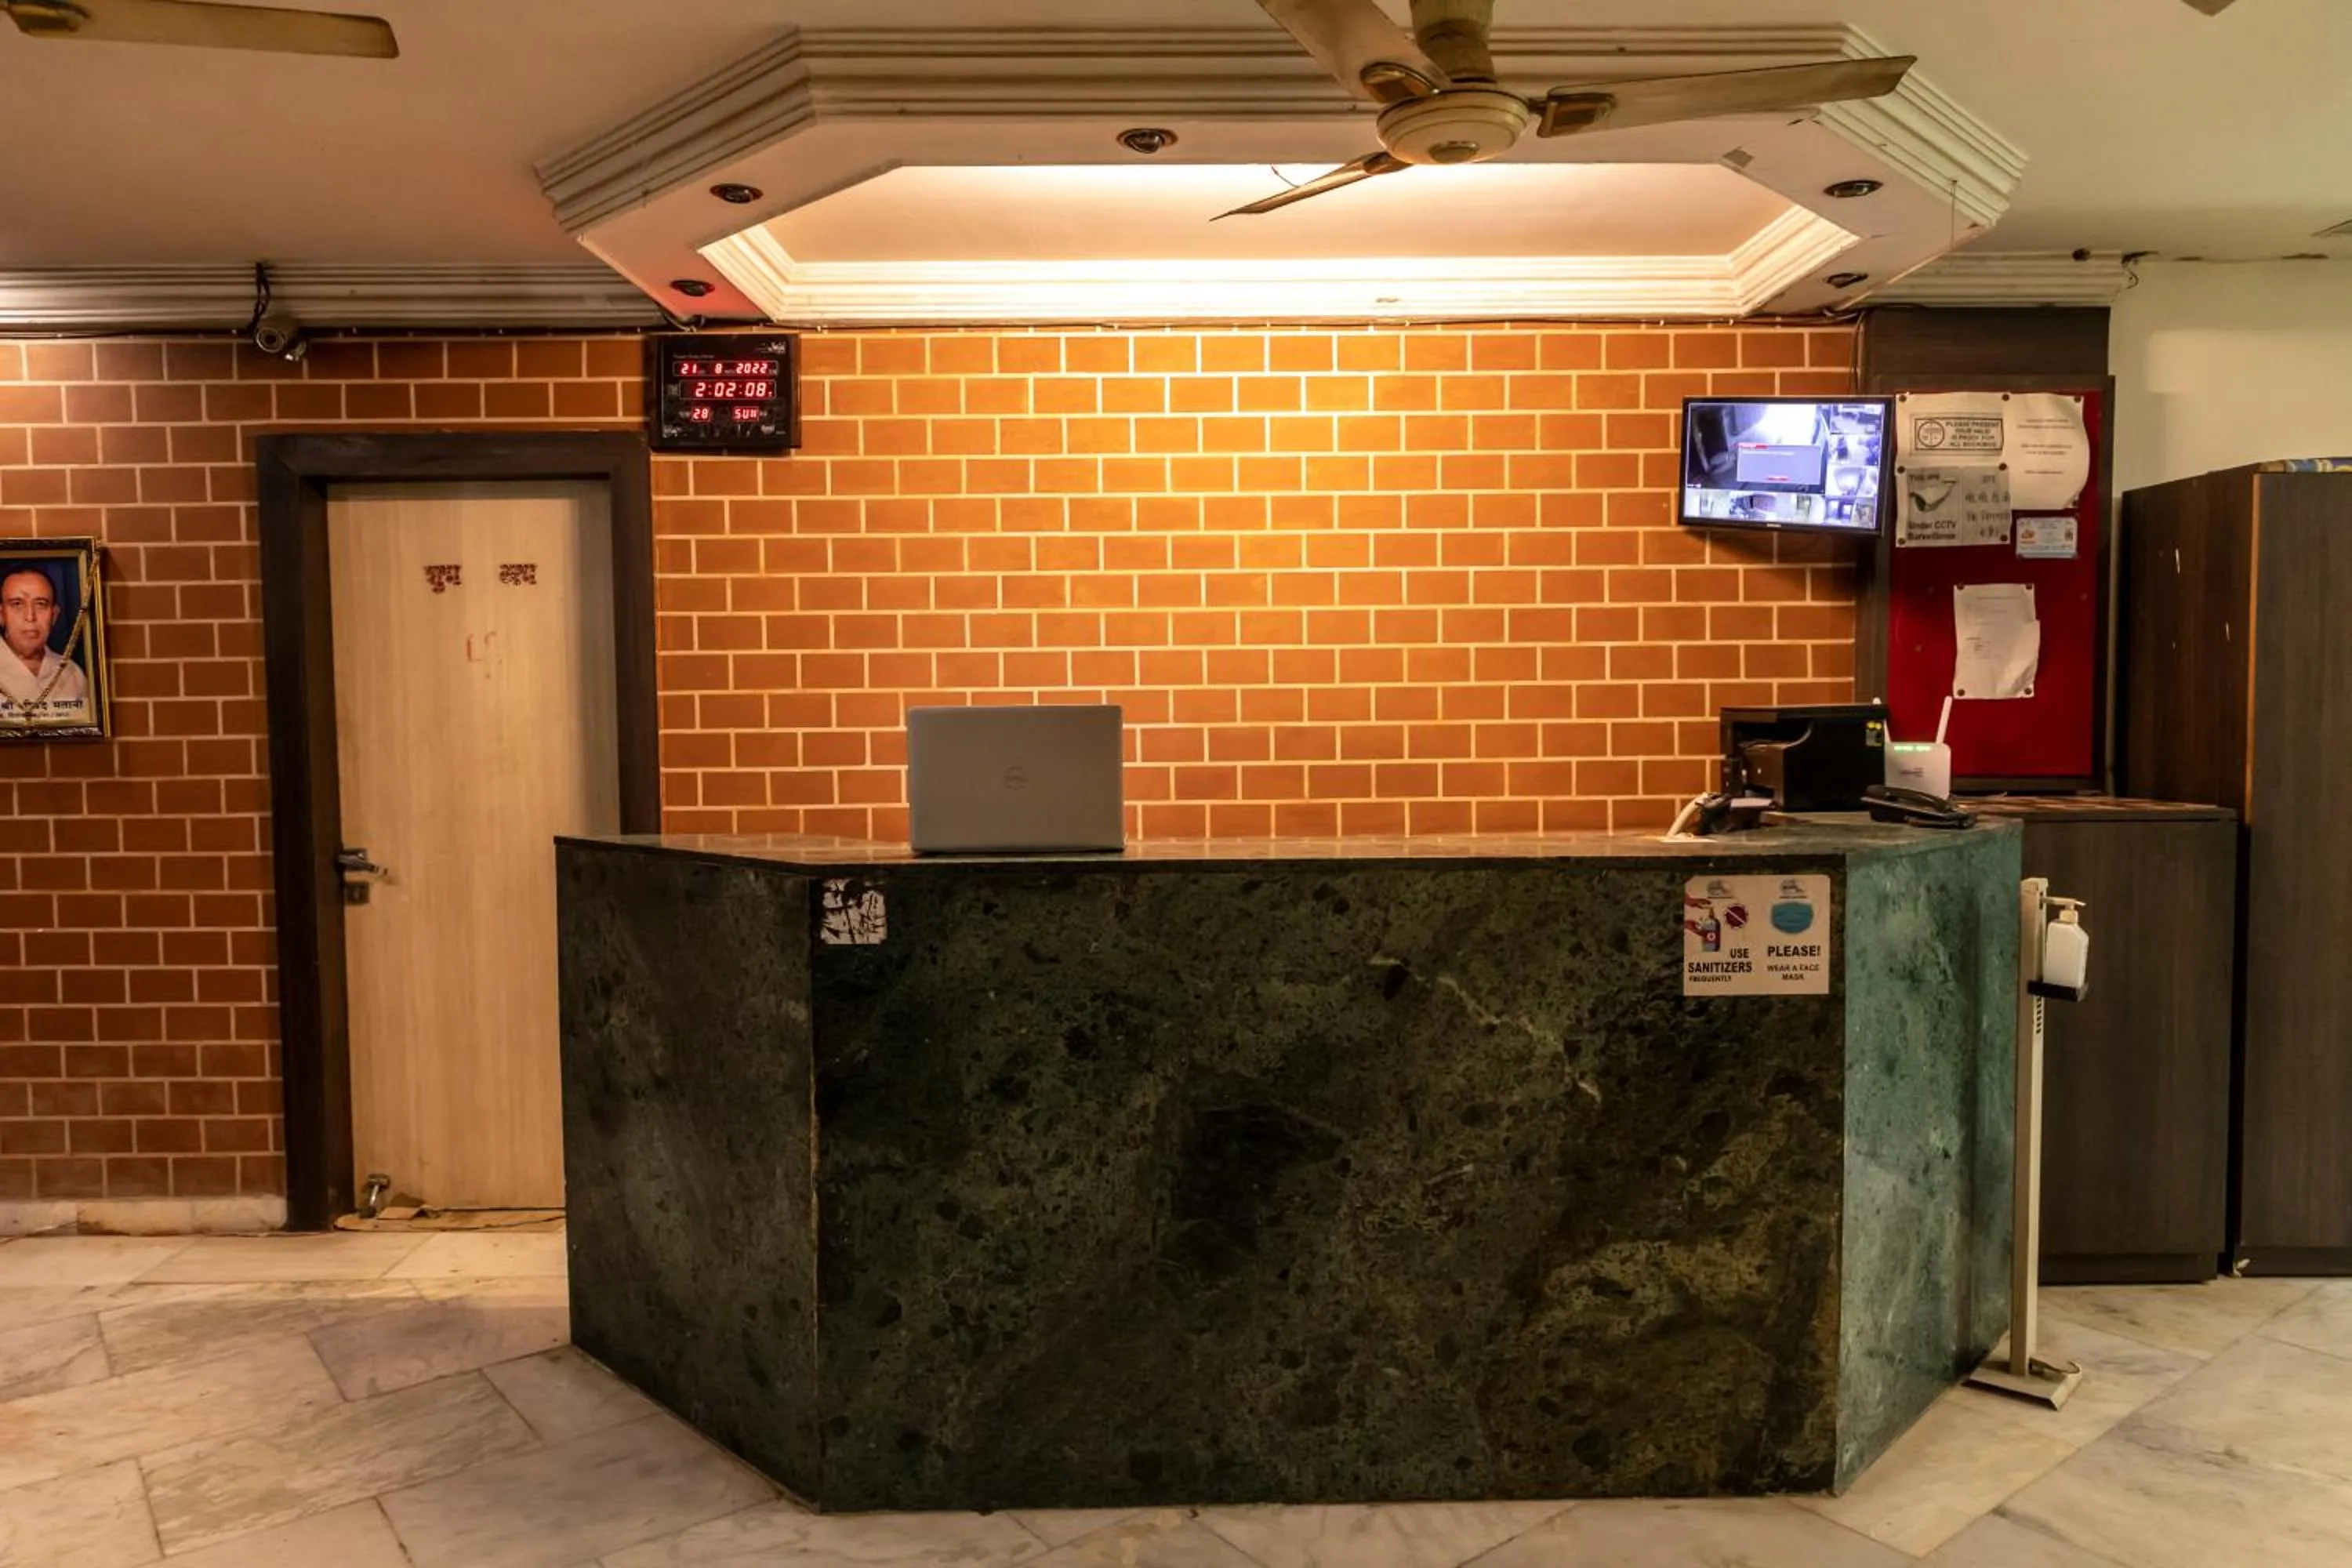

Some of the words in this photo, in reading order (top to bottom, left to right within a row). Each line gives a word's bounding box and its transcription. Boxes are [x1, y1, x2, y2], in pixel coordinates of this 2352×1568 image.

[681, 363, 697, 375] 21
[714, 363, 723, 374] 8
[735, 363, 768, 374] 2022
[692, 408, 709, 419] 28
[1934, 520, 1956, 529] CCTV
[1730, 948, 1749, 959] USE
[1767, 945, 1820, 957] PLEASE!
[1688, 961, 1752, 973] SANITIZERS
